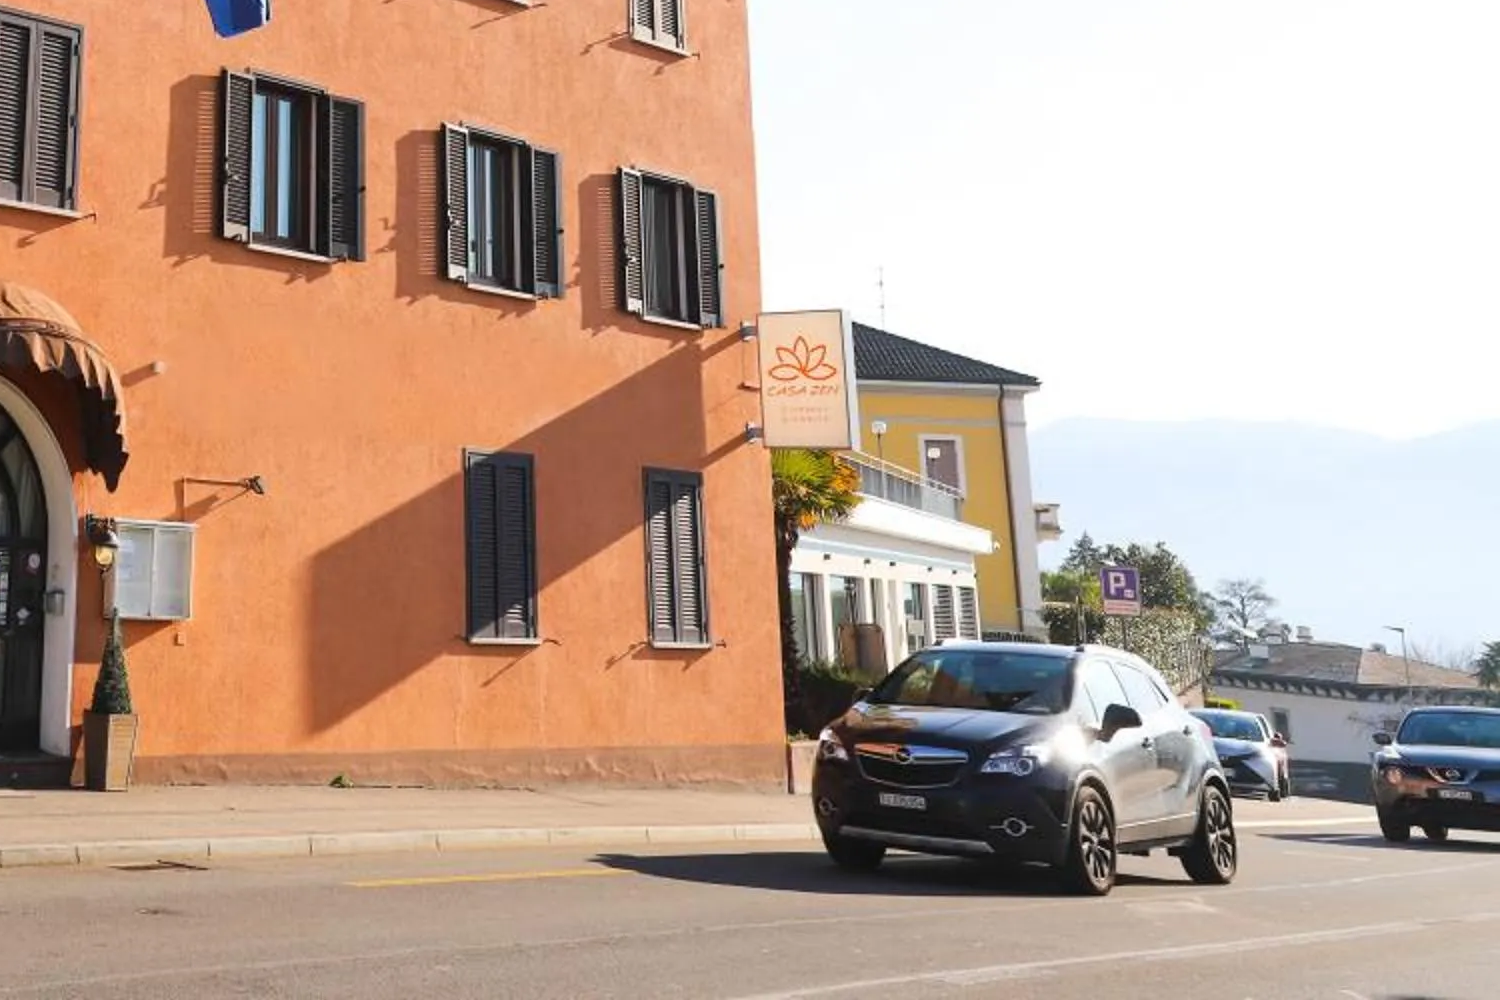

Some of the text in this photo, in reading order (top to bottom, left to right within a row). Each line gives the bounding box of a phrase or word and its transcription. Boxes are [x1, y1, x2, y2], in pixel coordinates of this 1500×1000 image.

[767, 384, 839, 397] CASA ZEN
[1108, 571, 1126, 596] P
